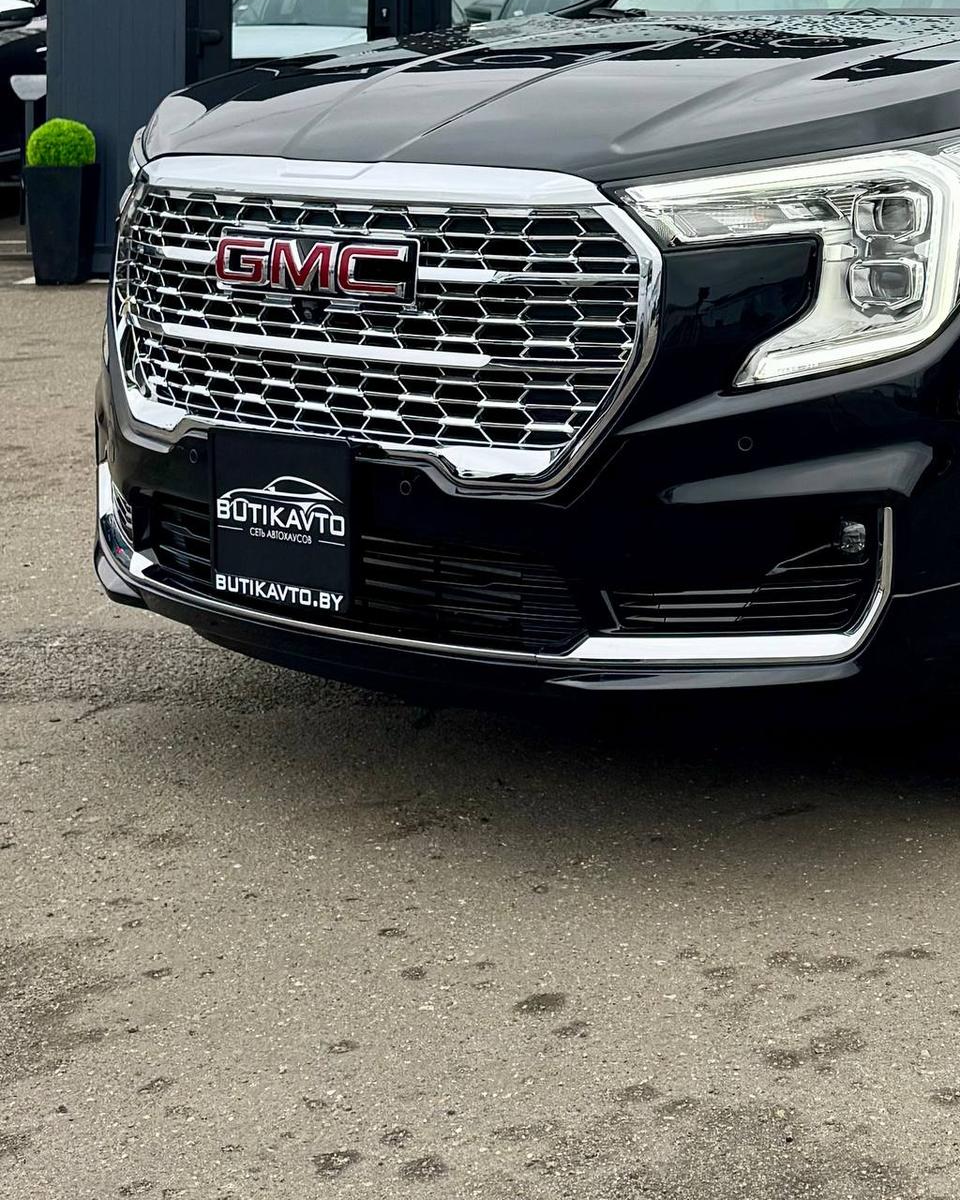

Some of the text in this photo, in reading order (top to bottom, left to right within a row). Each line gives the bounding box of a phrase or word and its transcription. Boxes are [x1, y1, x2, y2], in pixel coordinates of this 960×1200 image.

[215, 236, 409, 298] GMC
[216, 498, 345, 536] BUTIKAVTO
[249, 527, 312, 544] СЕТЬ АВТОХАУСОВ
[215, 573, 344, 612] BUTIKAVTO.BY
